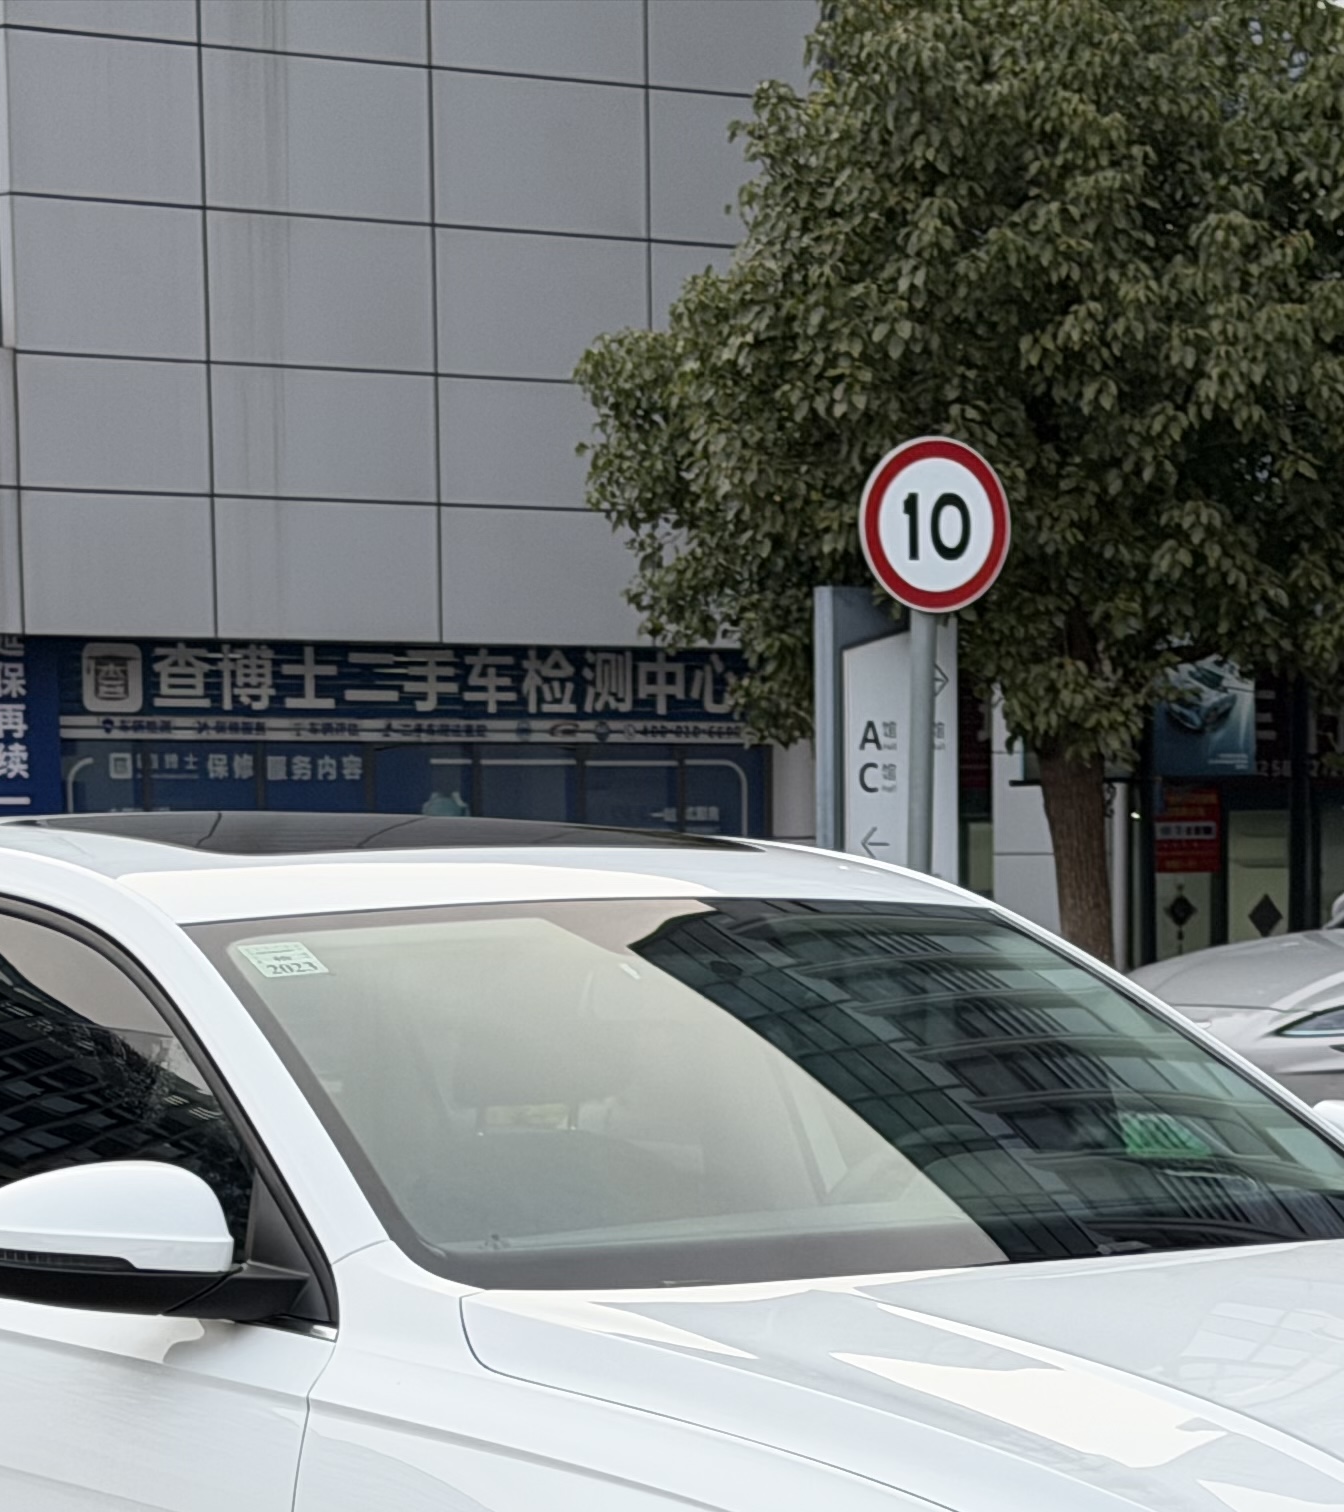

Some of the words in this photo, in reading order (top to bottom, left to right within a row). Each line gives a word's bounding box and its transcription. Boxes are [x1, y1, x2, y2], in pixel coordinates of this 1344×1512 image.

[902, 492, 971, 561] 10
[151, 642, 735, 716] 查博士二手车检测中心
[859, 720, 882, 750] A
[859, 762, 879, 793] C
